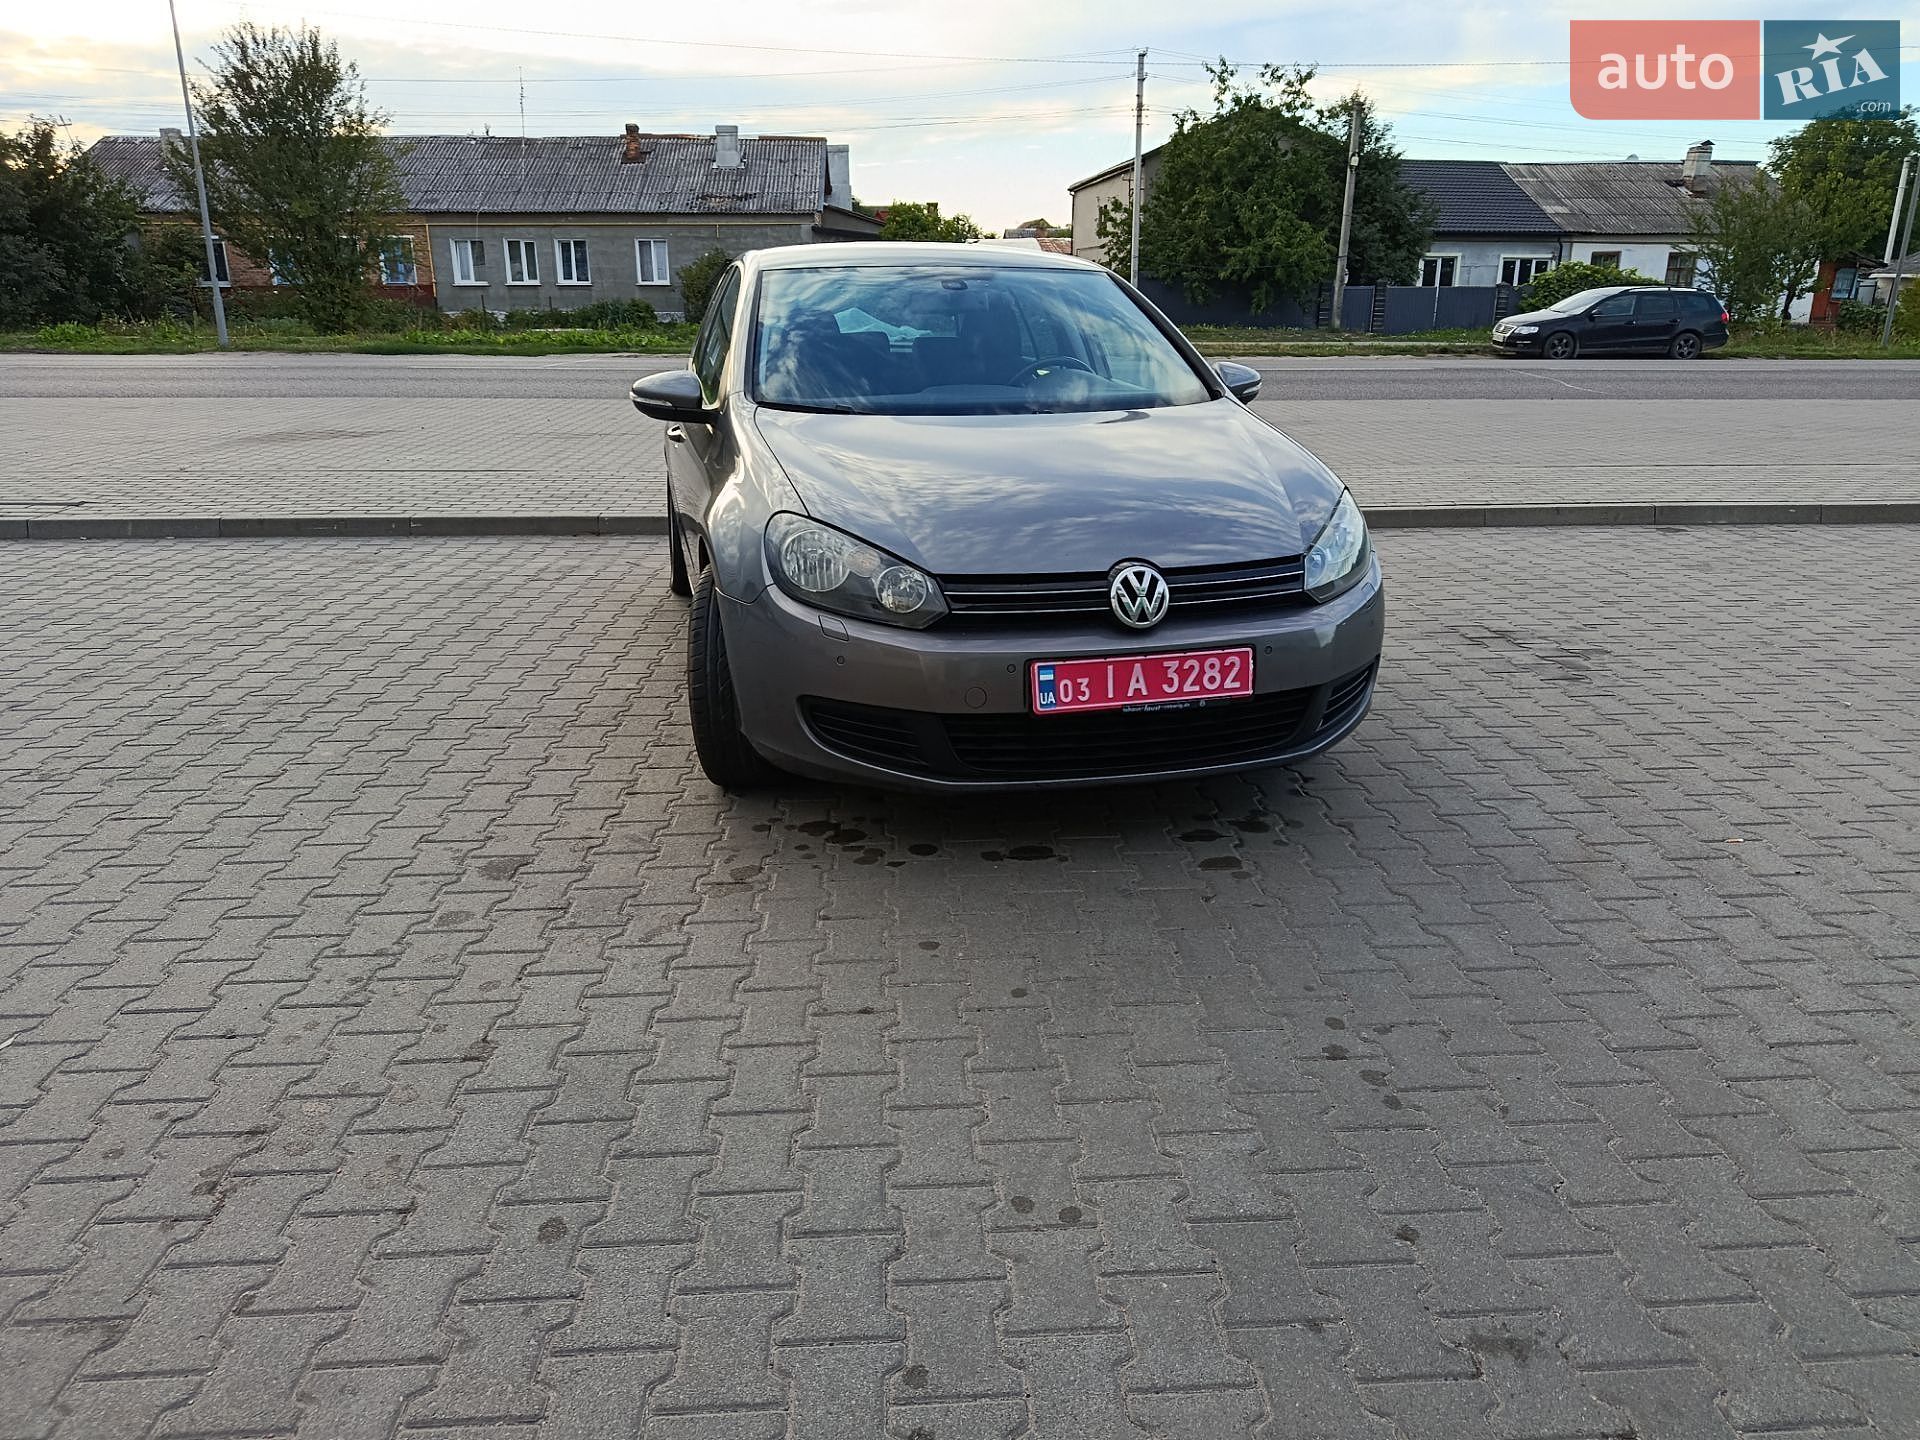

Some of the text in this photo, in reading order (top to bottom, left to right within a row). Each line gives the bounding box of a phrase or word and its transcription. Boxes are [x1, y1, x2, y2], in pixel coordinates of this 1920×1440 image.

[1111, 566, 1169, 628] VW
[1040, 693, 1056, 704] UA
[1059, 656, 1241, 703] 03 IA 3282
